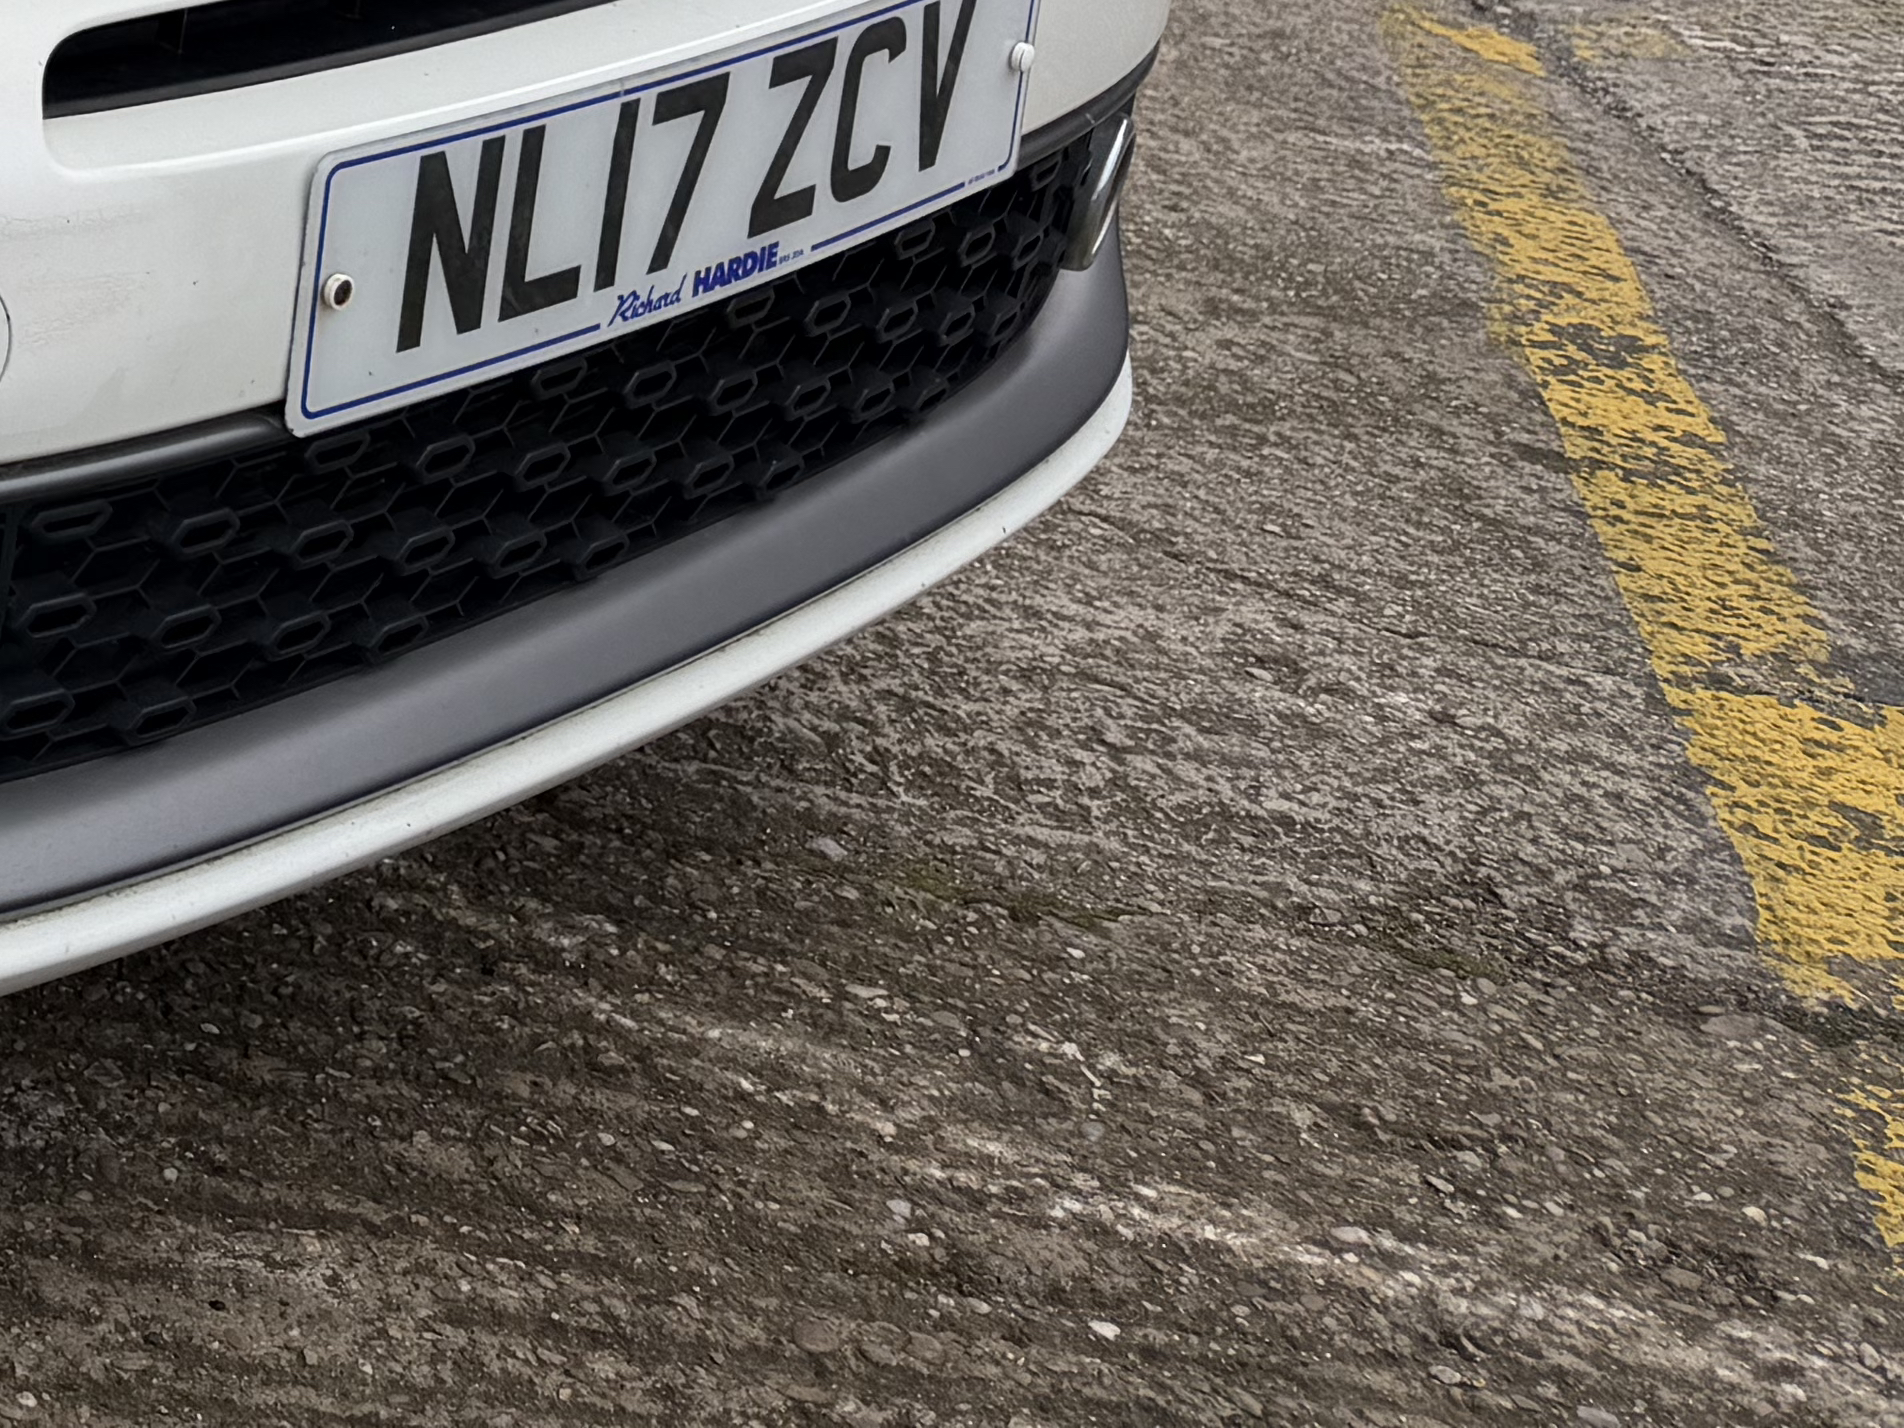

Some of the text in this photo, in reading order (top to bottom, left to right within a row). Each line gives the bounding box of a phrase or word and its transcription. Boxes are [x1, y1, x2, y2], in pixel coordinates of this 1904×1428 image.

[396, 72, 731, 354] NL17
[607, 241, 780, 328] Richard HARDIE
